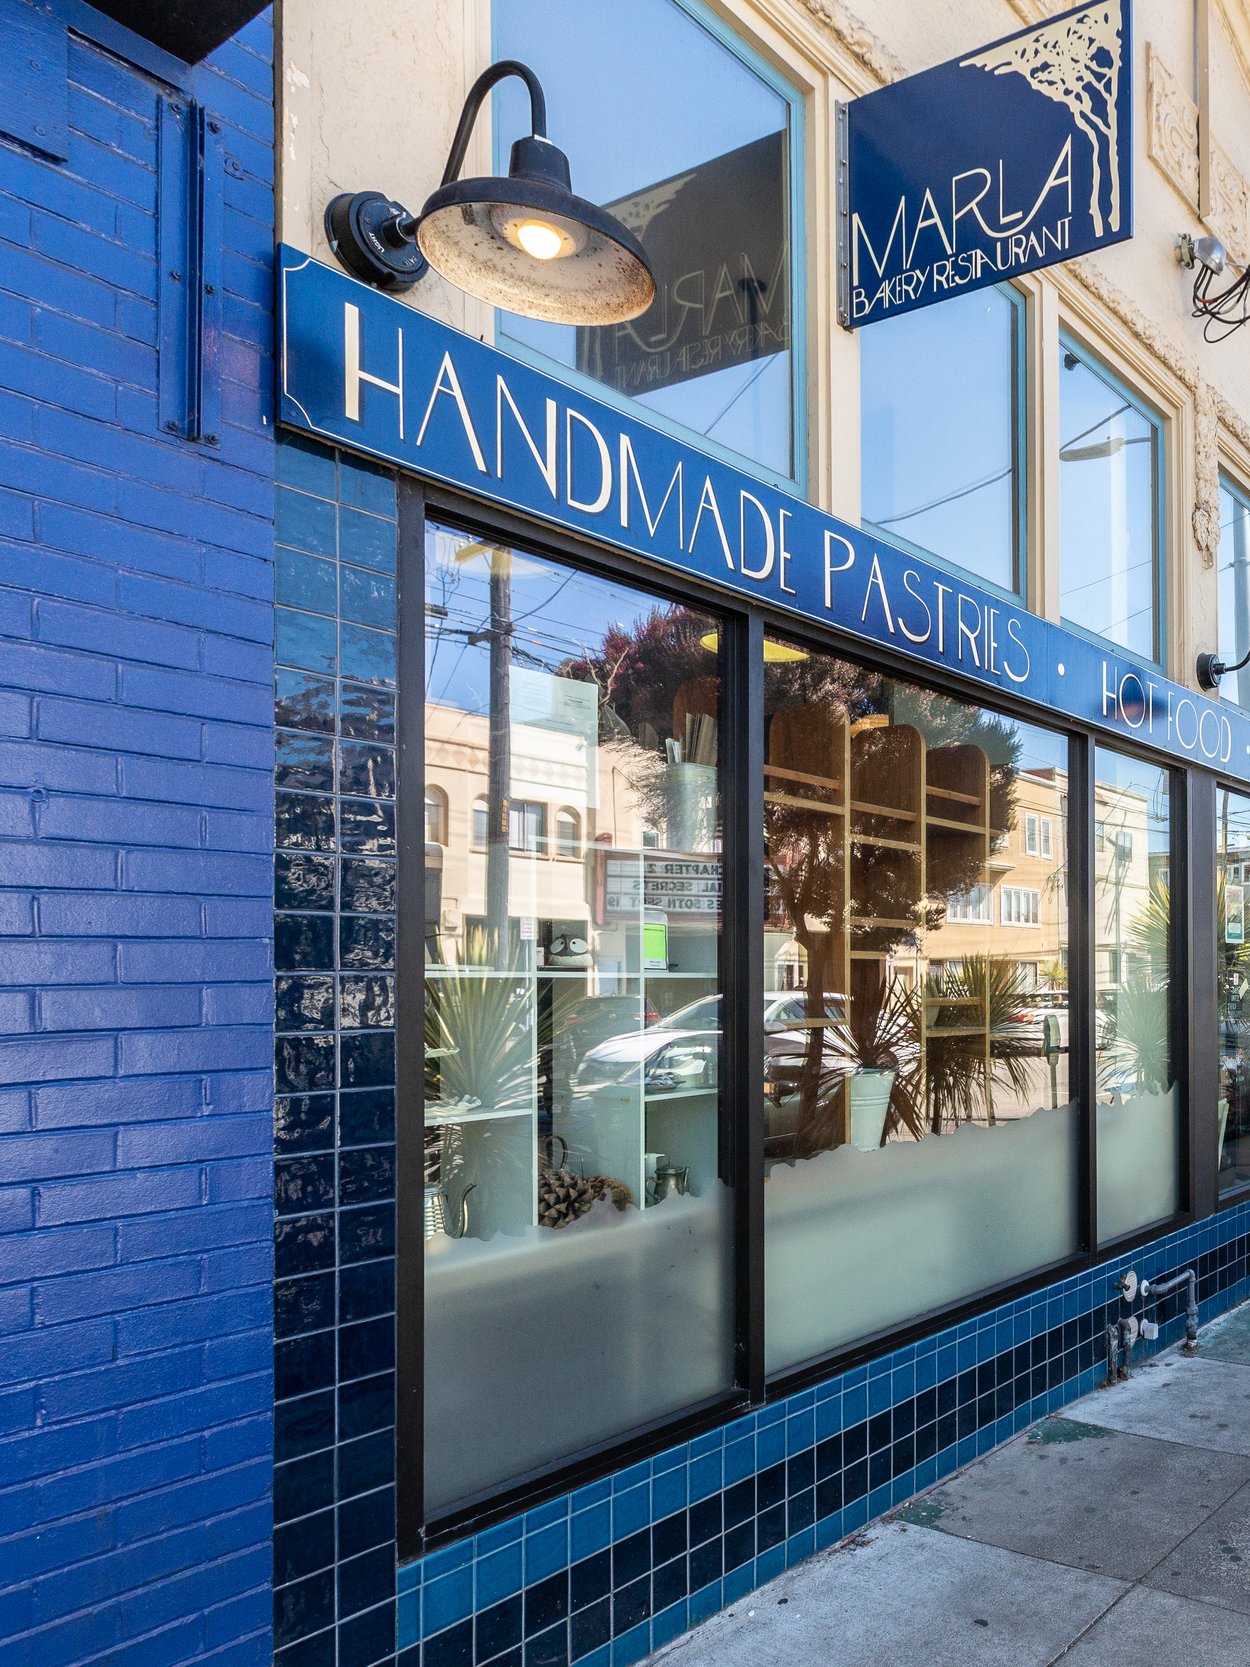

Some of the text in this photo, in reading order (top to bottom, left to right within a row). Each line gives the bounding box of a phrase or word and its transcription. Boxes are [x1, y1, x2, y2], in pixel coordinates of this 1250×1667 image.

[852, 133, 1072, 286] MARLA
[853, 216, 1073, 318] BAKERY RESTAURANT
[344, 302, 796, 595] HANDMADE
[824, 530, 1031, 683] PASTRIES
[1102, 660, 1157, 733] HOT
[1166, 688, 1232, 763] FOOD
